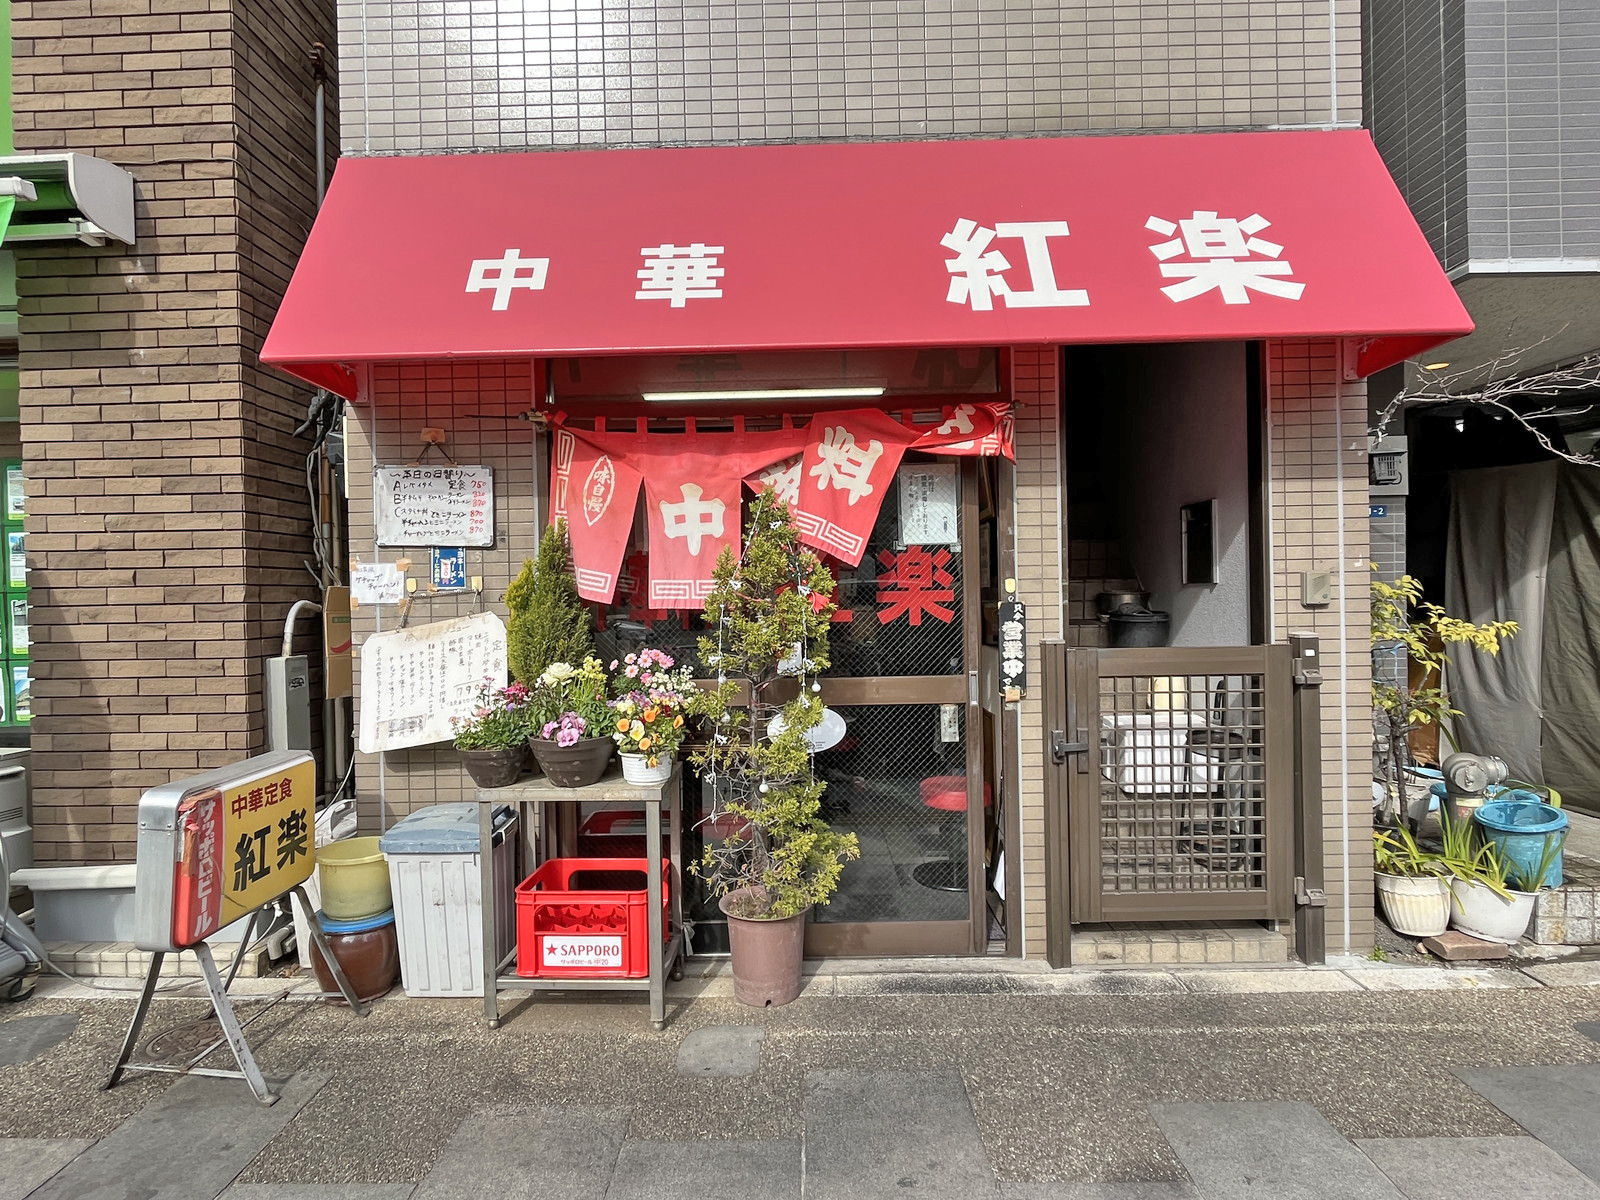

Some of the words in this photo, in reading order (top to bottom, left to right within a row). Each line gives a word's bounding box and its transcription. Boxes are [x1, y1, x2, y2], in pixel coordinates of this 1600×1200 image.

[465, 243, 725, 311] 中華
[939, 210, 1307, 311] 紅楽
[659, 482, 726, 556] 中
[876, 545, 955, 626] 楽
[1001, 620, 1025, 678] 営業中
[231, 778, 293, 819] 中華定食
[194, 800, 216, 938] サッポロビール
[233, 807, 308, 892] 紅楽
[560, 944, 620, 957] SAPPORO
